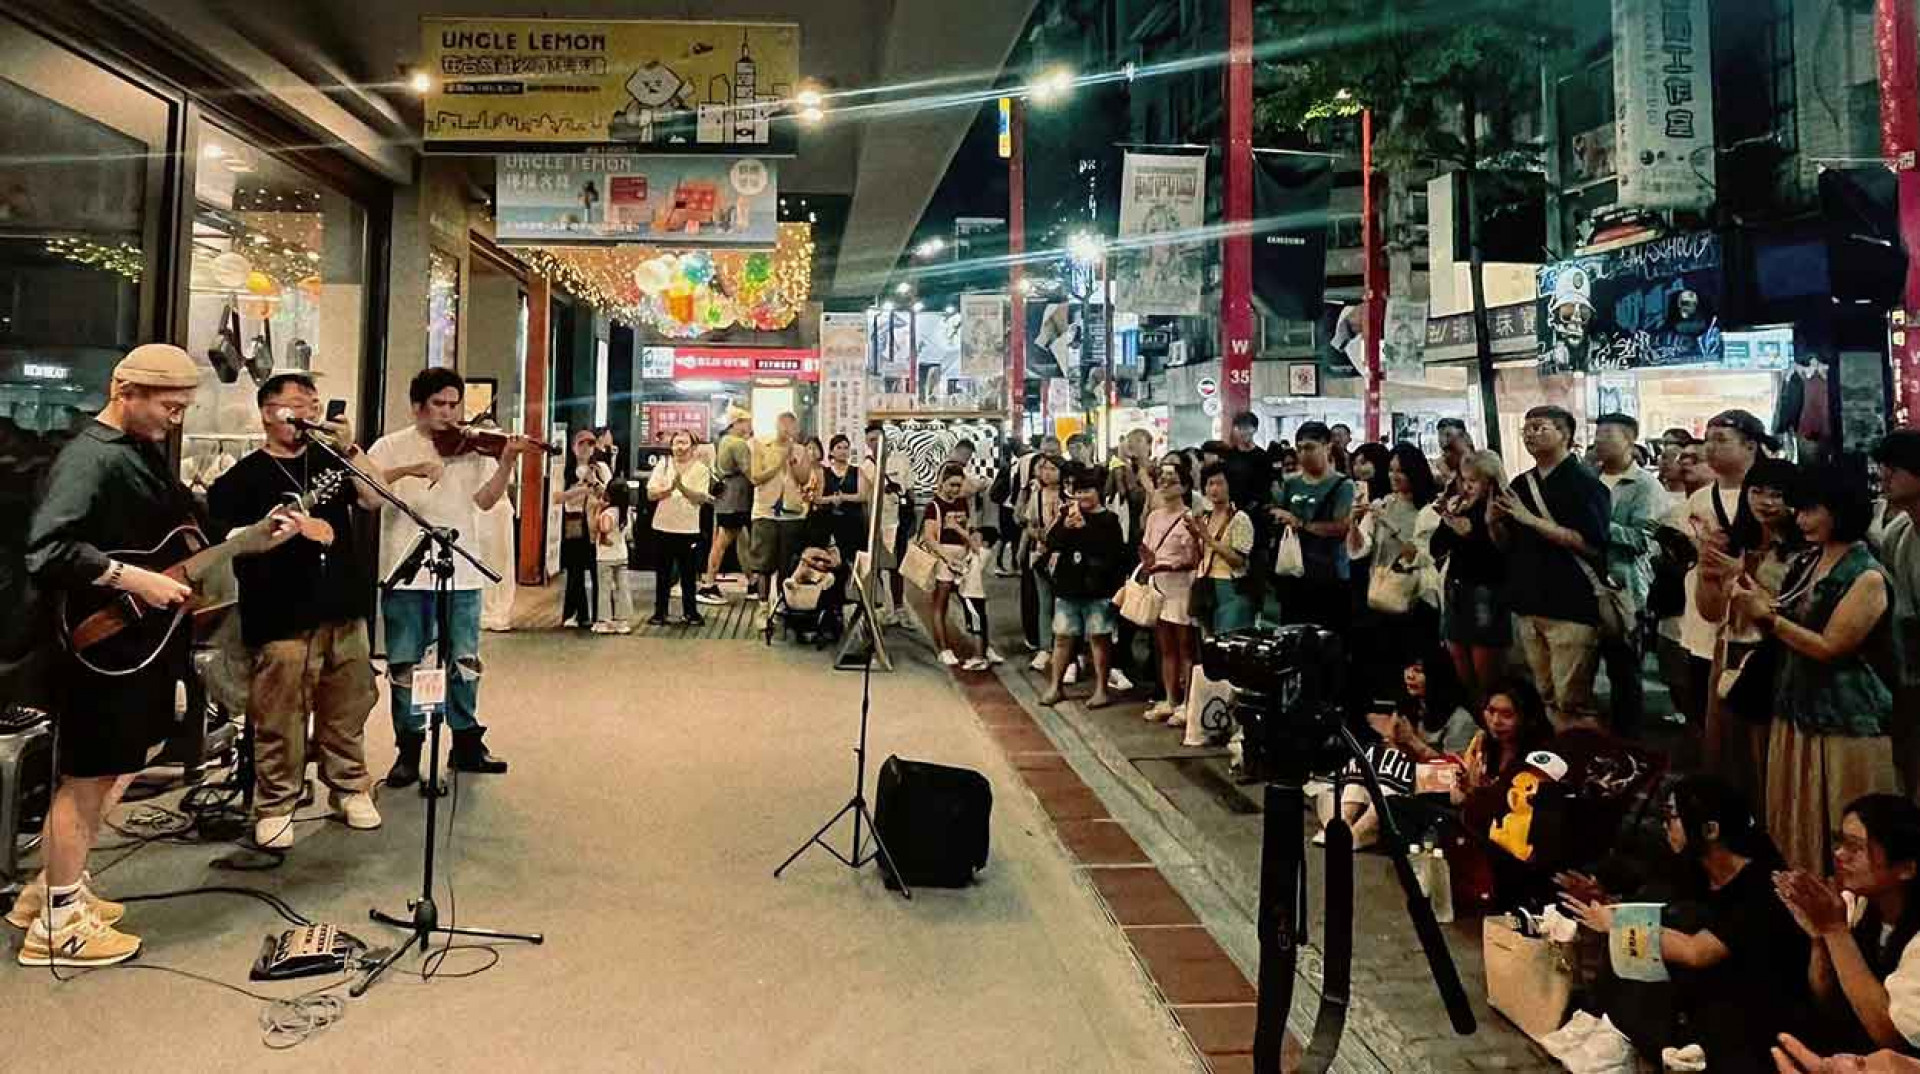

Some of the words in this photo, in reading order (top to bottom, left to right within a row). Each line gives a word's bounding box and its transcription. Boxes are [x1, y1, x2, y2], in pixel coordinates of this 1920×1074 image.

[442, 32, 517, 50] UNCLE
[528, 31, 606, 50] LEMON
[505, 154, 566, 170] UNCLE
[1231, 338, 1249, 355] W
[1229, 369, 1251, 384] 35
